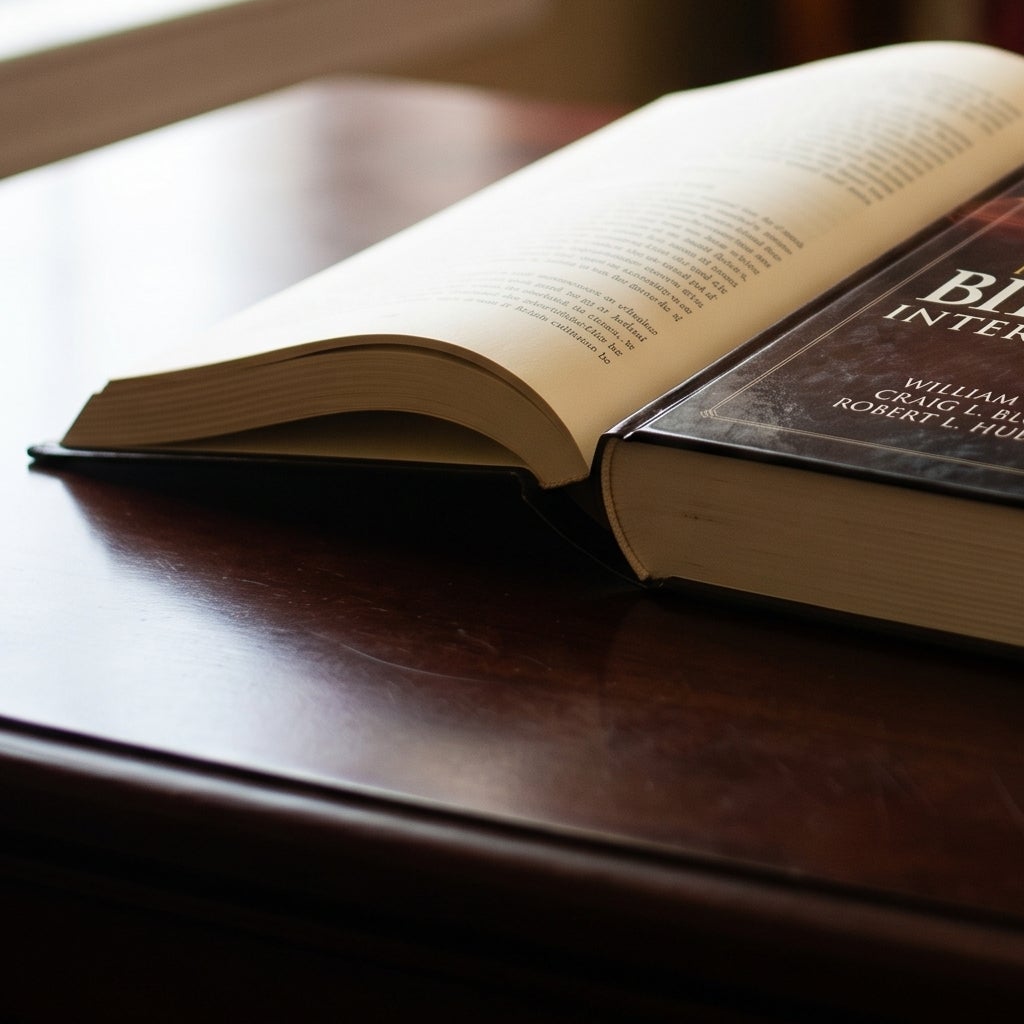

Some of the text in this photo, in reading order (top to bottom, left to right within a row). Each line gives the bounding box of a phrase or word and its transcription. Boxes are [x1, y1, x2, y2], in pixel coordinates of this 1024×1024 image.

[874, 389, 960, 412] CRAIG
[964, 404, 982, 417] L.
[904, 377, 1019, 406] WILLIAM
[832, 397, 940, 423] ROBERT
[940, 416, 959, 429] L.
